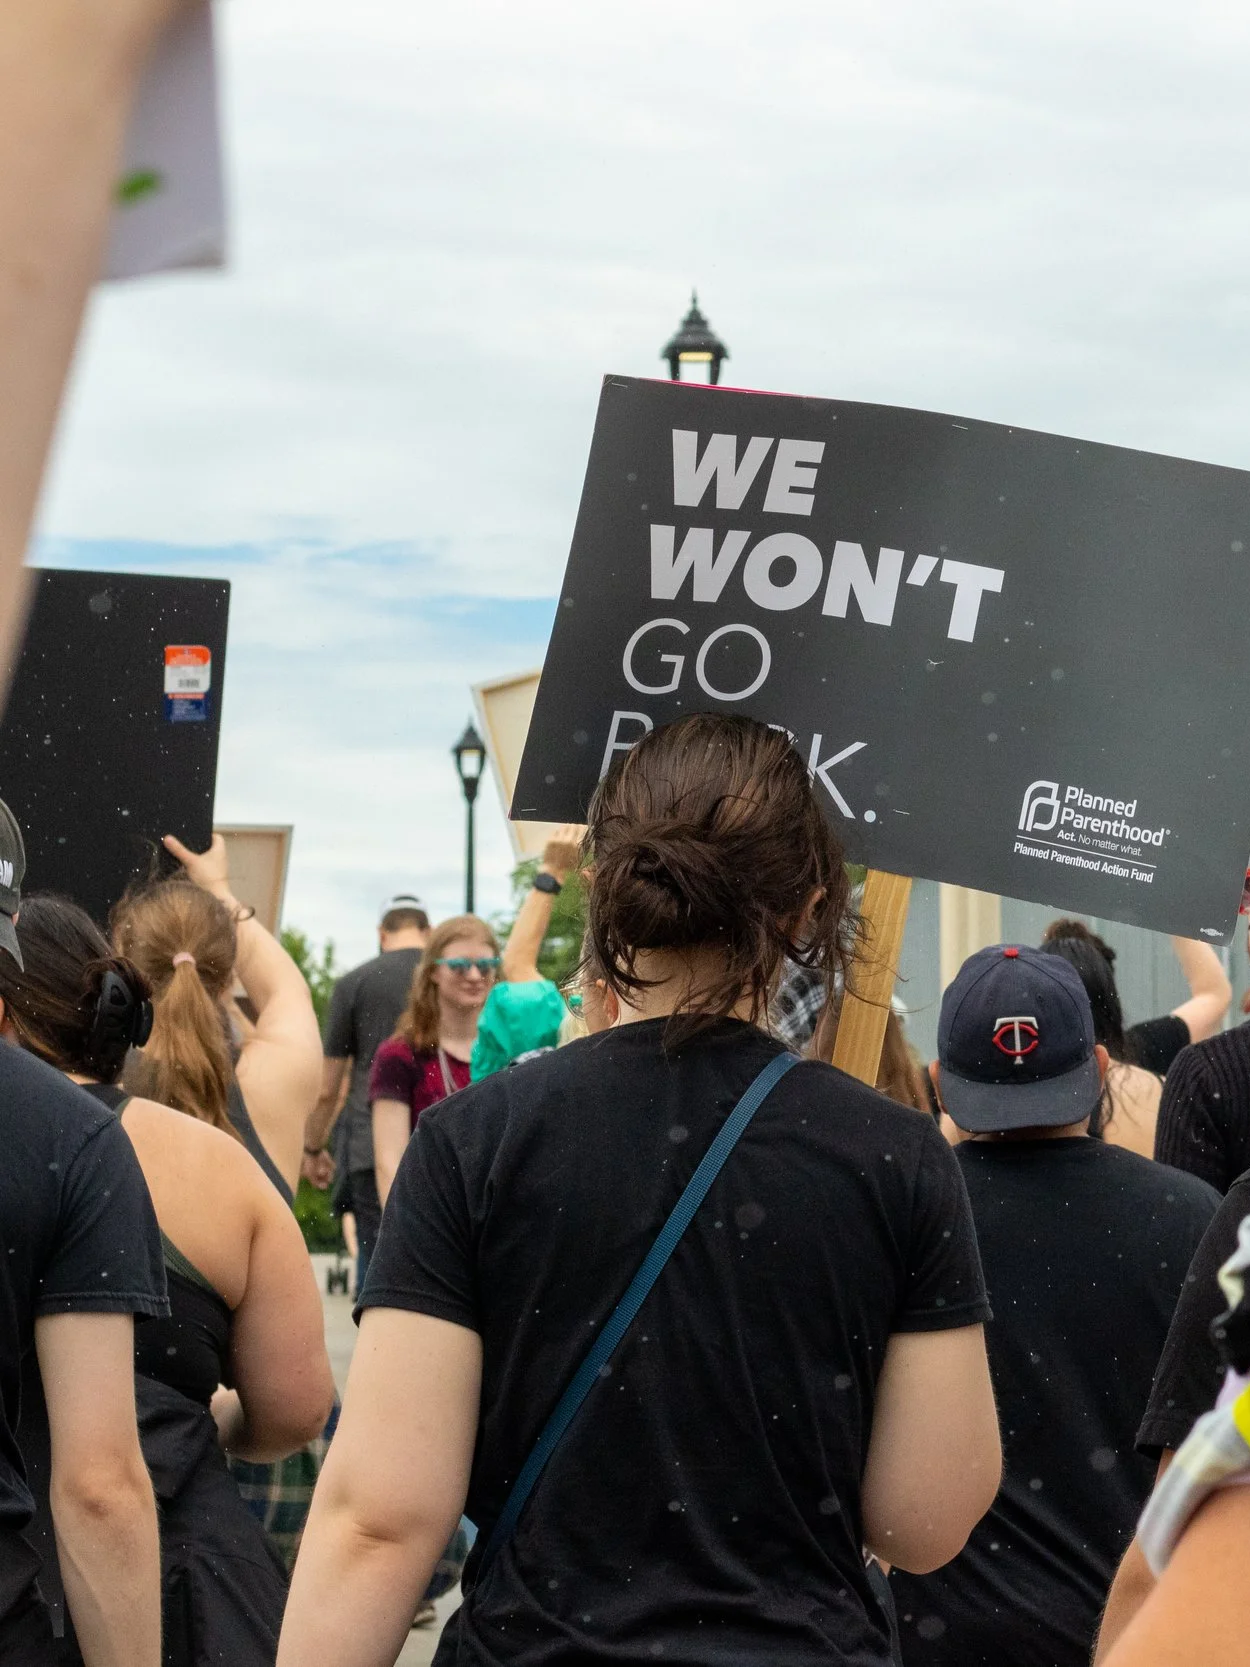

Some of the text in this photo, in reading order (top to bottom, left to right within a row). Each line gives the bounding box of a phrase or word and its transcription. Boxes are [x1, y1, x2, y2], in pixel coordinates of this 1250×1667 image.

[672, 429, 825, 516] WE
[650, 524, 1005, 643] WON'T
[622, 617, 771, 701] GO
[1065, 786, 1137, 818] Planned
[1057, 829, 1143, 857] Act. No matter what.
[1060, 807, 1165, 846] Parenthood
[1013, 842, 1154, 884] Planned Parenthood Action Fund
